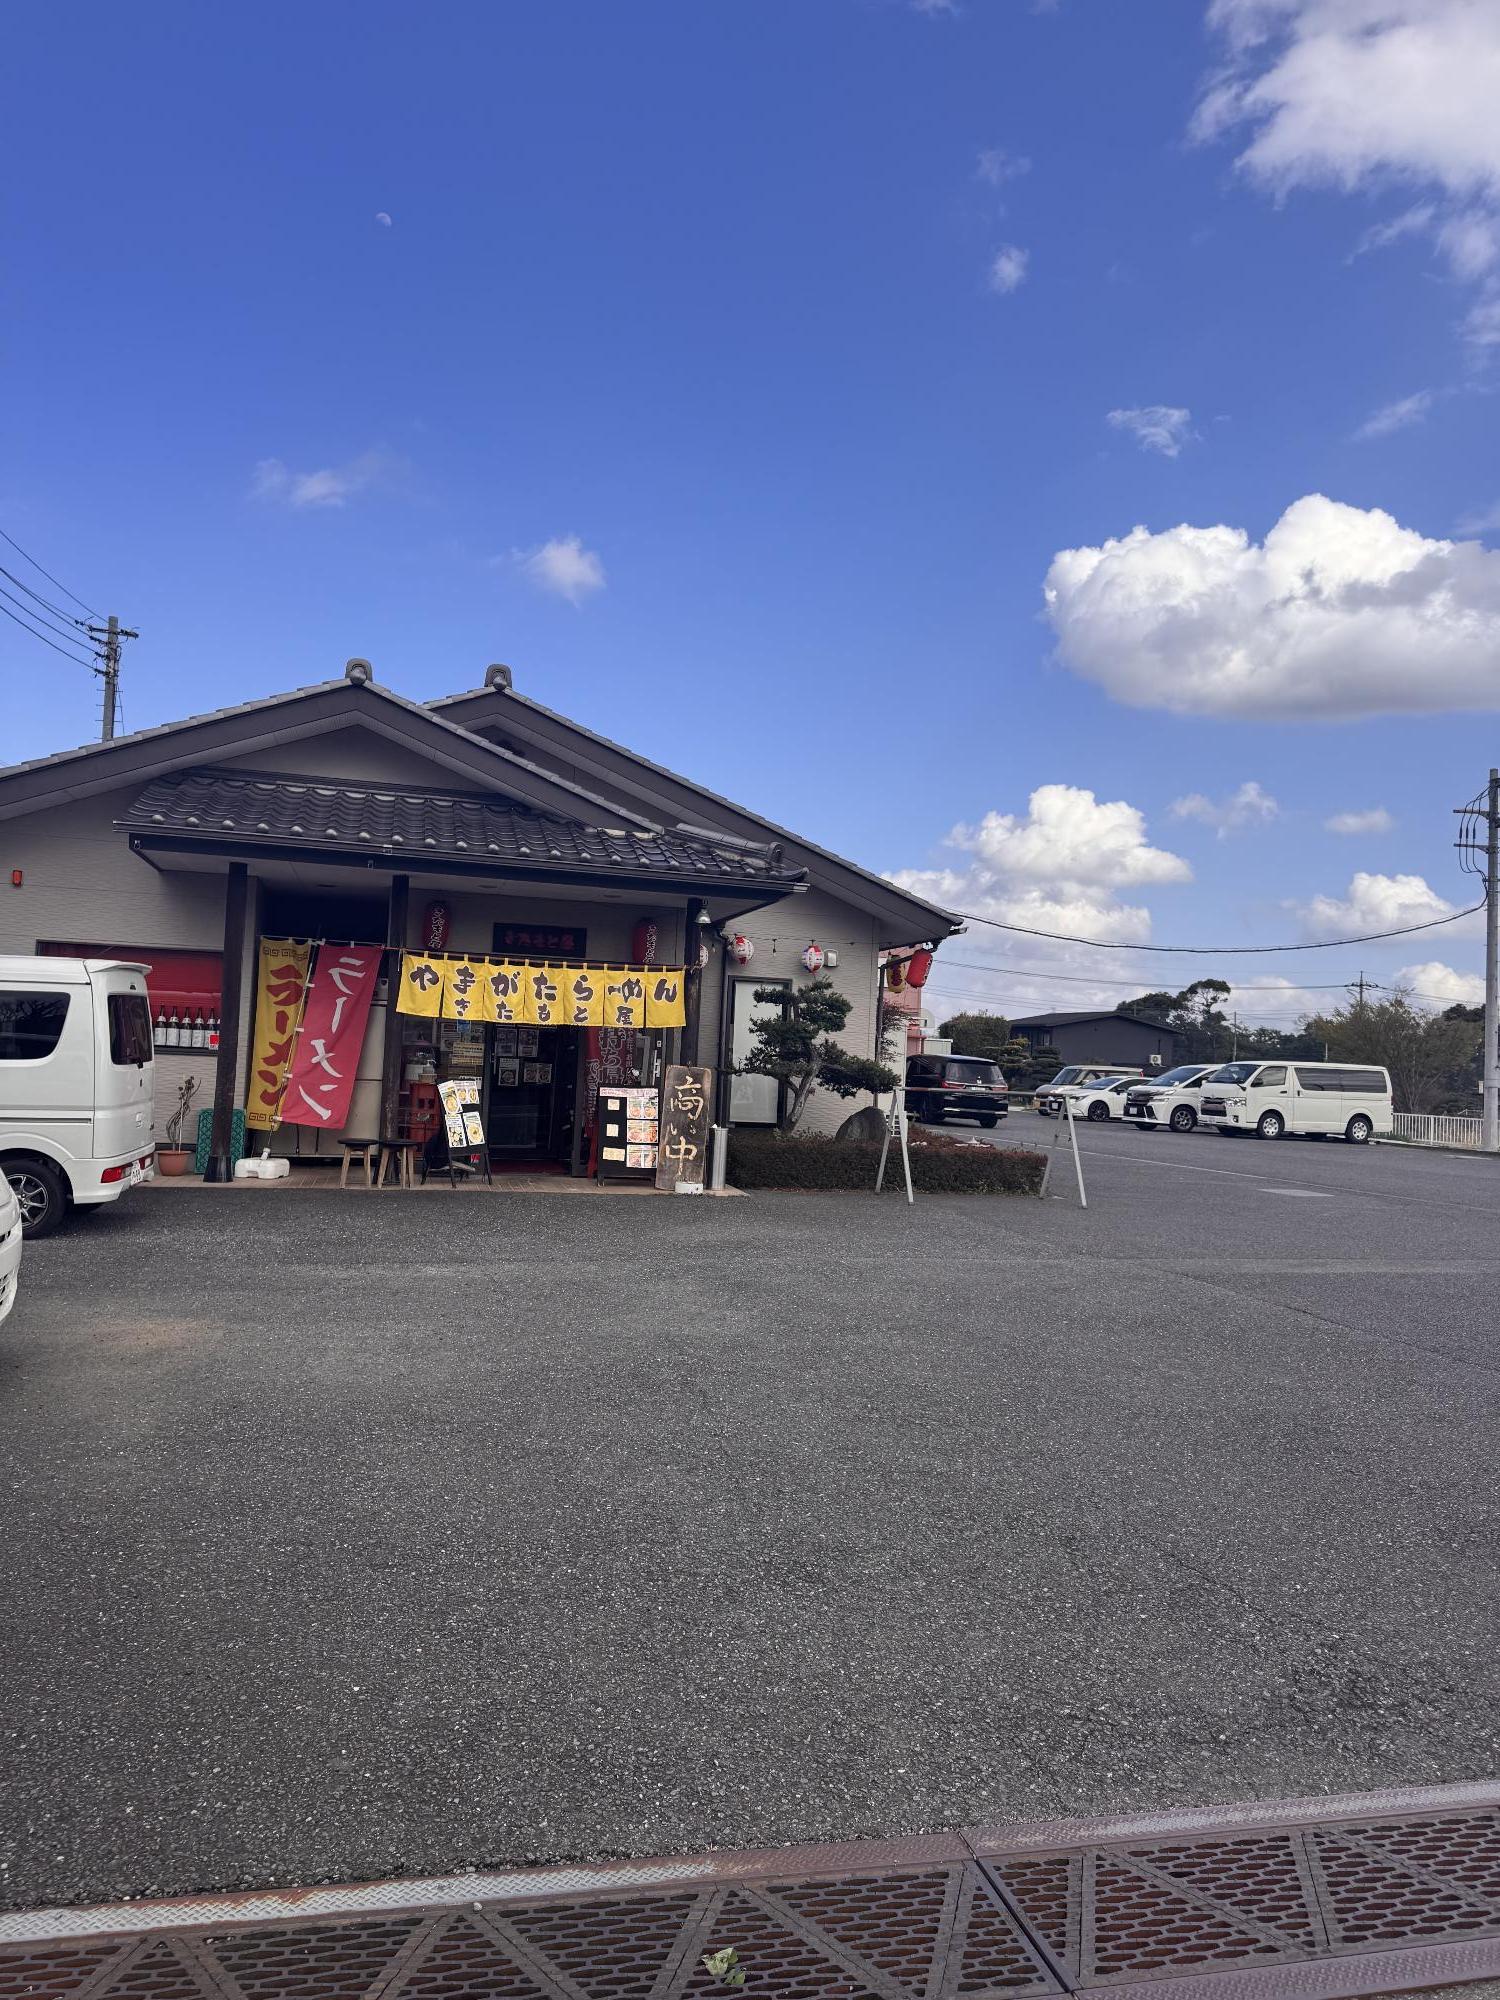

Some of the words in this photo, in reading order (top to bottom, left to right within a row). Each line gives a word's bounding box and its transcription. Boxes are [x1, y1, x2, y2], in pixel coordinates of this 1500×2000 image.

[410, 964, 678, 1004] やまがたらーめん
[454, 998, 634, 1026] きたもと屋
[257, 963, 303, 1107] ラーメン
[298, 956, 366, 1120] ラーメン
